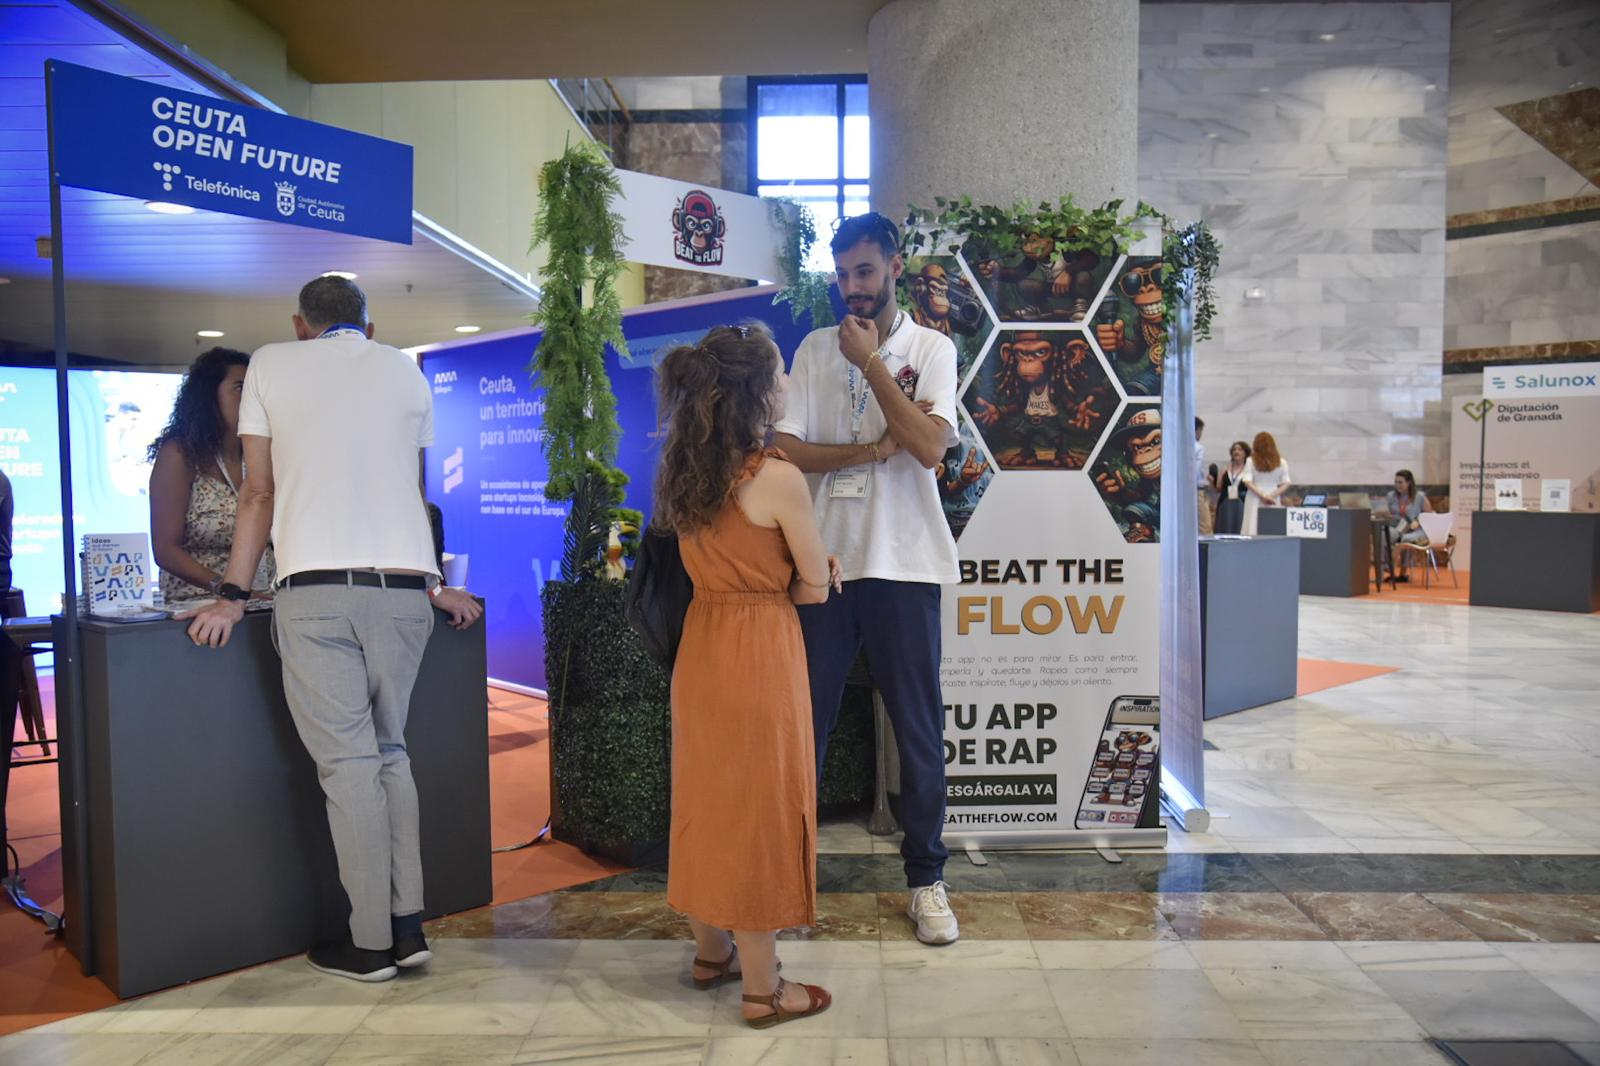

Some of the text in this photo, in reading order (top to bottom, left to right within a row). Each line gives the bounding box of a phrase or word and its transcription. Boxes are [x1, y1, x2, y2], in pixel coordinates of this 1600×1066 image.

[152, 97, 247, 137] CEUTA
[152, 125, 341, 184] OPEN FUTURE
[185, 175, 261, 201] Telefónica
[308, 204, 345, 222] Ceuta
[676, 240, 693, 260] BEAT
[703, 248, 721, 262] FLOW
[480, 376, 516, 394] Ceuta,
[1515, 375, 1596, 388] Salunox
[480, 395, 546, 420] un territori
[1497, 403, 1559, 413] Diputación
[1497, 413, 1562, 422] de Granada
[480, 430, 504, 450] para
[1459, 462, 1519, 470] Impusamos
[480, 480, 488, 489] Un
[522, 480, 530, 489] de
[480, 492, 547, 505] para startups tecnológ
[480, 506, 491, 514] con
[491, 505, 506, 514] base
[515, 505, 521, 515] el
[521, 507, 531, 515] sur
[532, 505, 540, 515] de
[541, 505, 566, 518] Europa.
[1304, 520, 1324, 532] Log
[958, 558, 1125, 585] BEAT THE
[957, 595, 1126, 635] FLOW
[941, 655, 952, 664] ta
[958, 655, 976, 665] app
[998, 655, 1008, 663] es
[1013, 655, 1034, 665] para
[1068, 653, 1079, 662] Es
[1083, 655, 1104, 664] para
[978, 668, 984, 677] y
[1074, 666, 1098, 674] como
[1104, 665, 1138, 676] siempre
[1009, 677, 1031, 689] fluye
[1032, 679, 1038, 689] y
[943, 703, 1057, 730] TU APP
[943, 738, 1057, 765] DE RAP
[946, 781, 1054, 797] ESGÁRGALA YA
[943, 812, 1057, 824] EATTHEFLOW.COM
